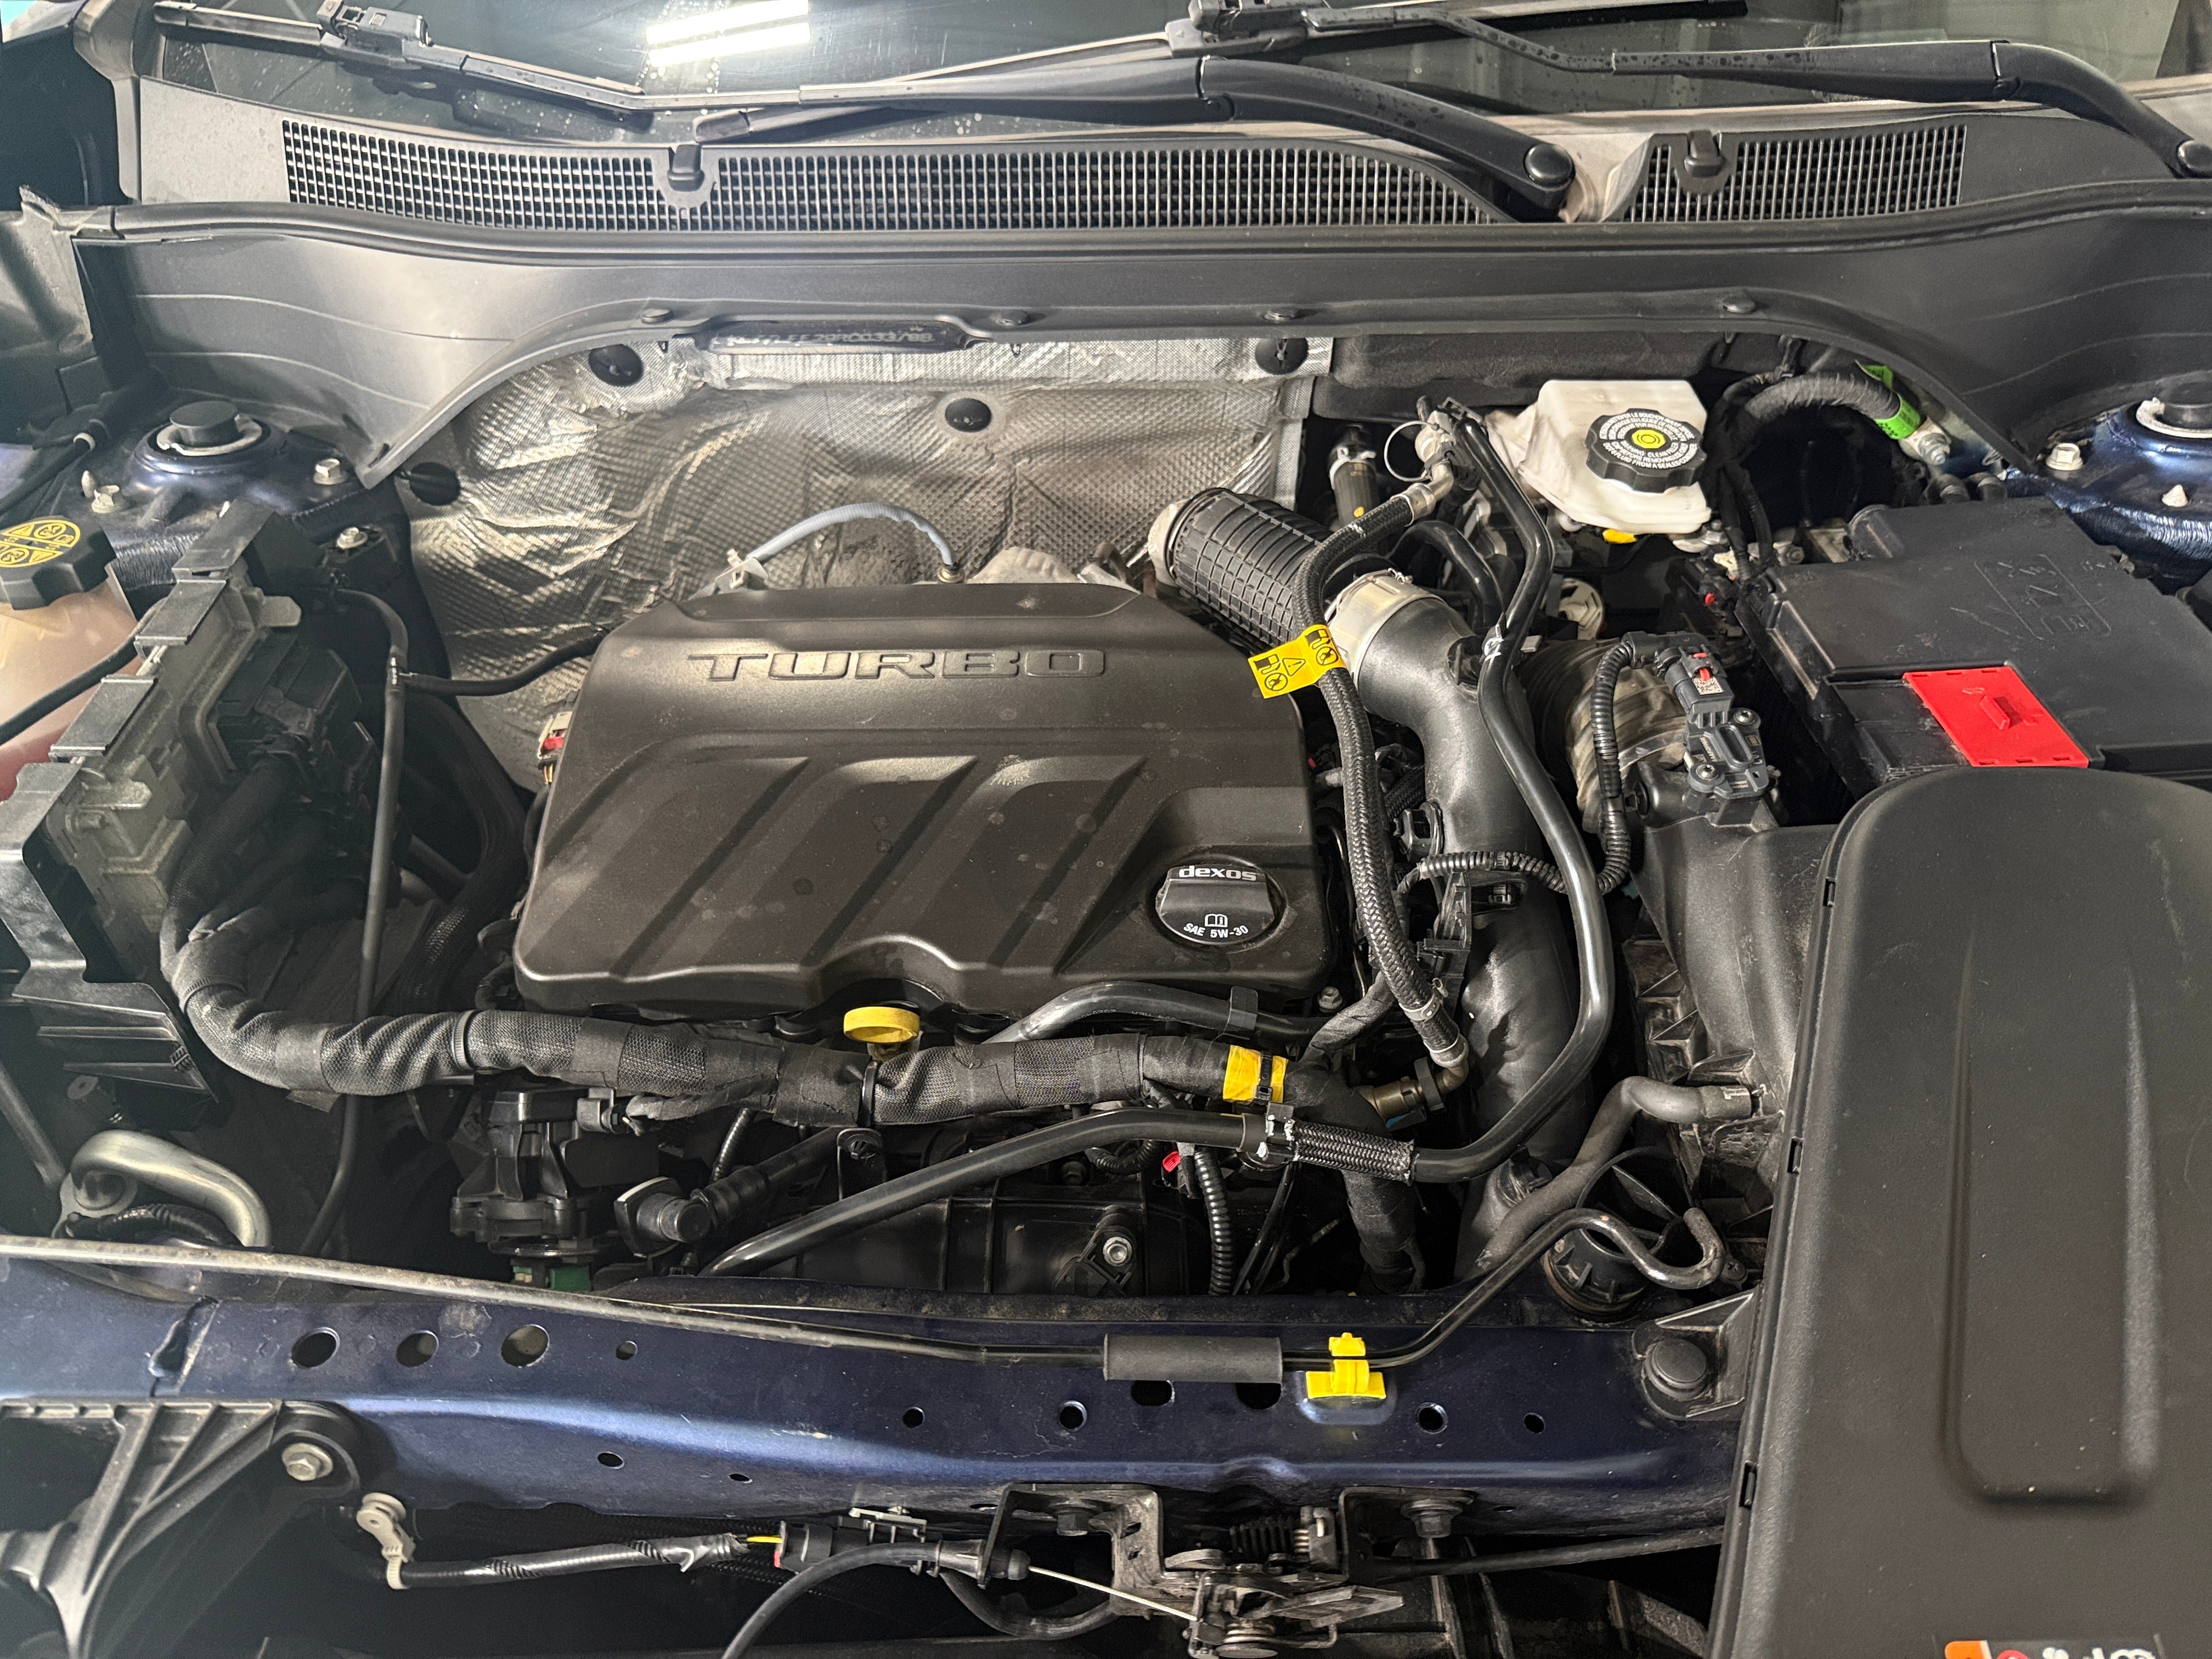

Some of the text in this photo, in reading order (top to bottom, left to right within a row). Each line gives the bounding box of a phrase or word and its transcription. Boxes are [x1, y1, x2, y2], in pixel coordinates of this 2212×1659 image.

[1638, 412, 1664, 421] BOUCHON
[1614, 452, 1632, 463] FLUID
[1632, 460, 1652, 468] FROM
[1657, 460, 1681, 469] SEALED
[688, 650, 1105, 682] TURBO
[1179, 865, 1257, 881] dexos
[1184, 923, 1249, 938] SAE 5W-30
